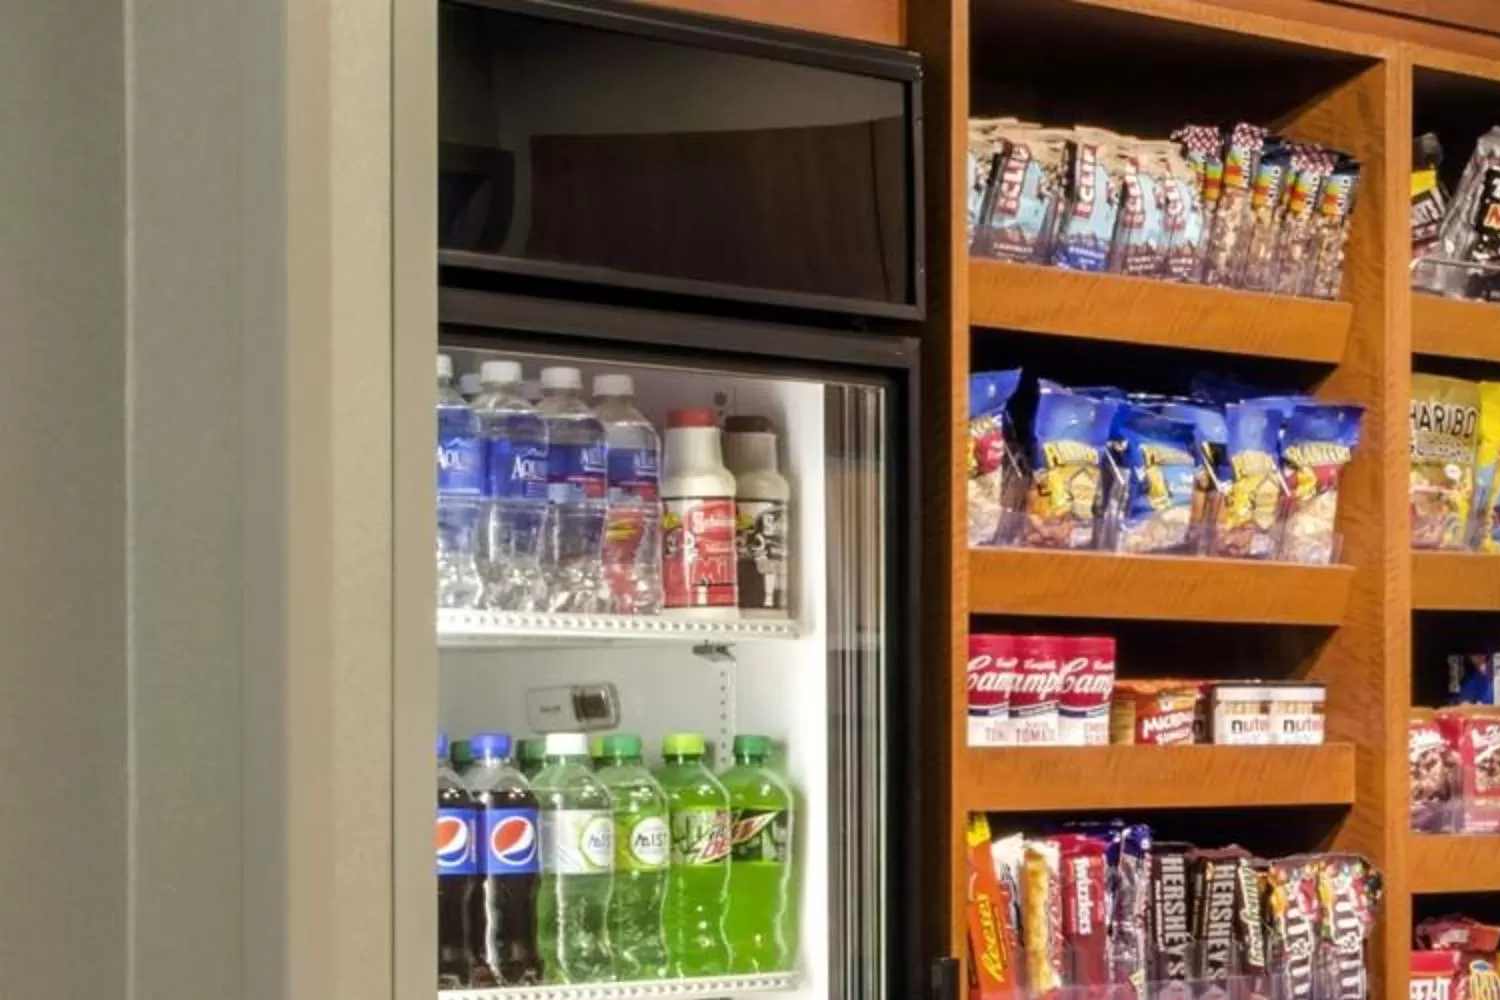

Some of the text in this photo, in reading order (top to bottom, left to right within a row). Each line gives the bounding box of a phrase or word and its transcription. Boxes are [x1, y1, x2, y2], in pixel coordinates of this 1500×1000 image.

[1231, 717, 1269, 734] nute
[1283, 717, 1323, 734] nute
[1161, 856, 1189, 978] HERSHEY'S
[1205, 864, 1236, 981] HERSHEY'S
